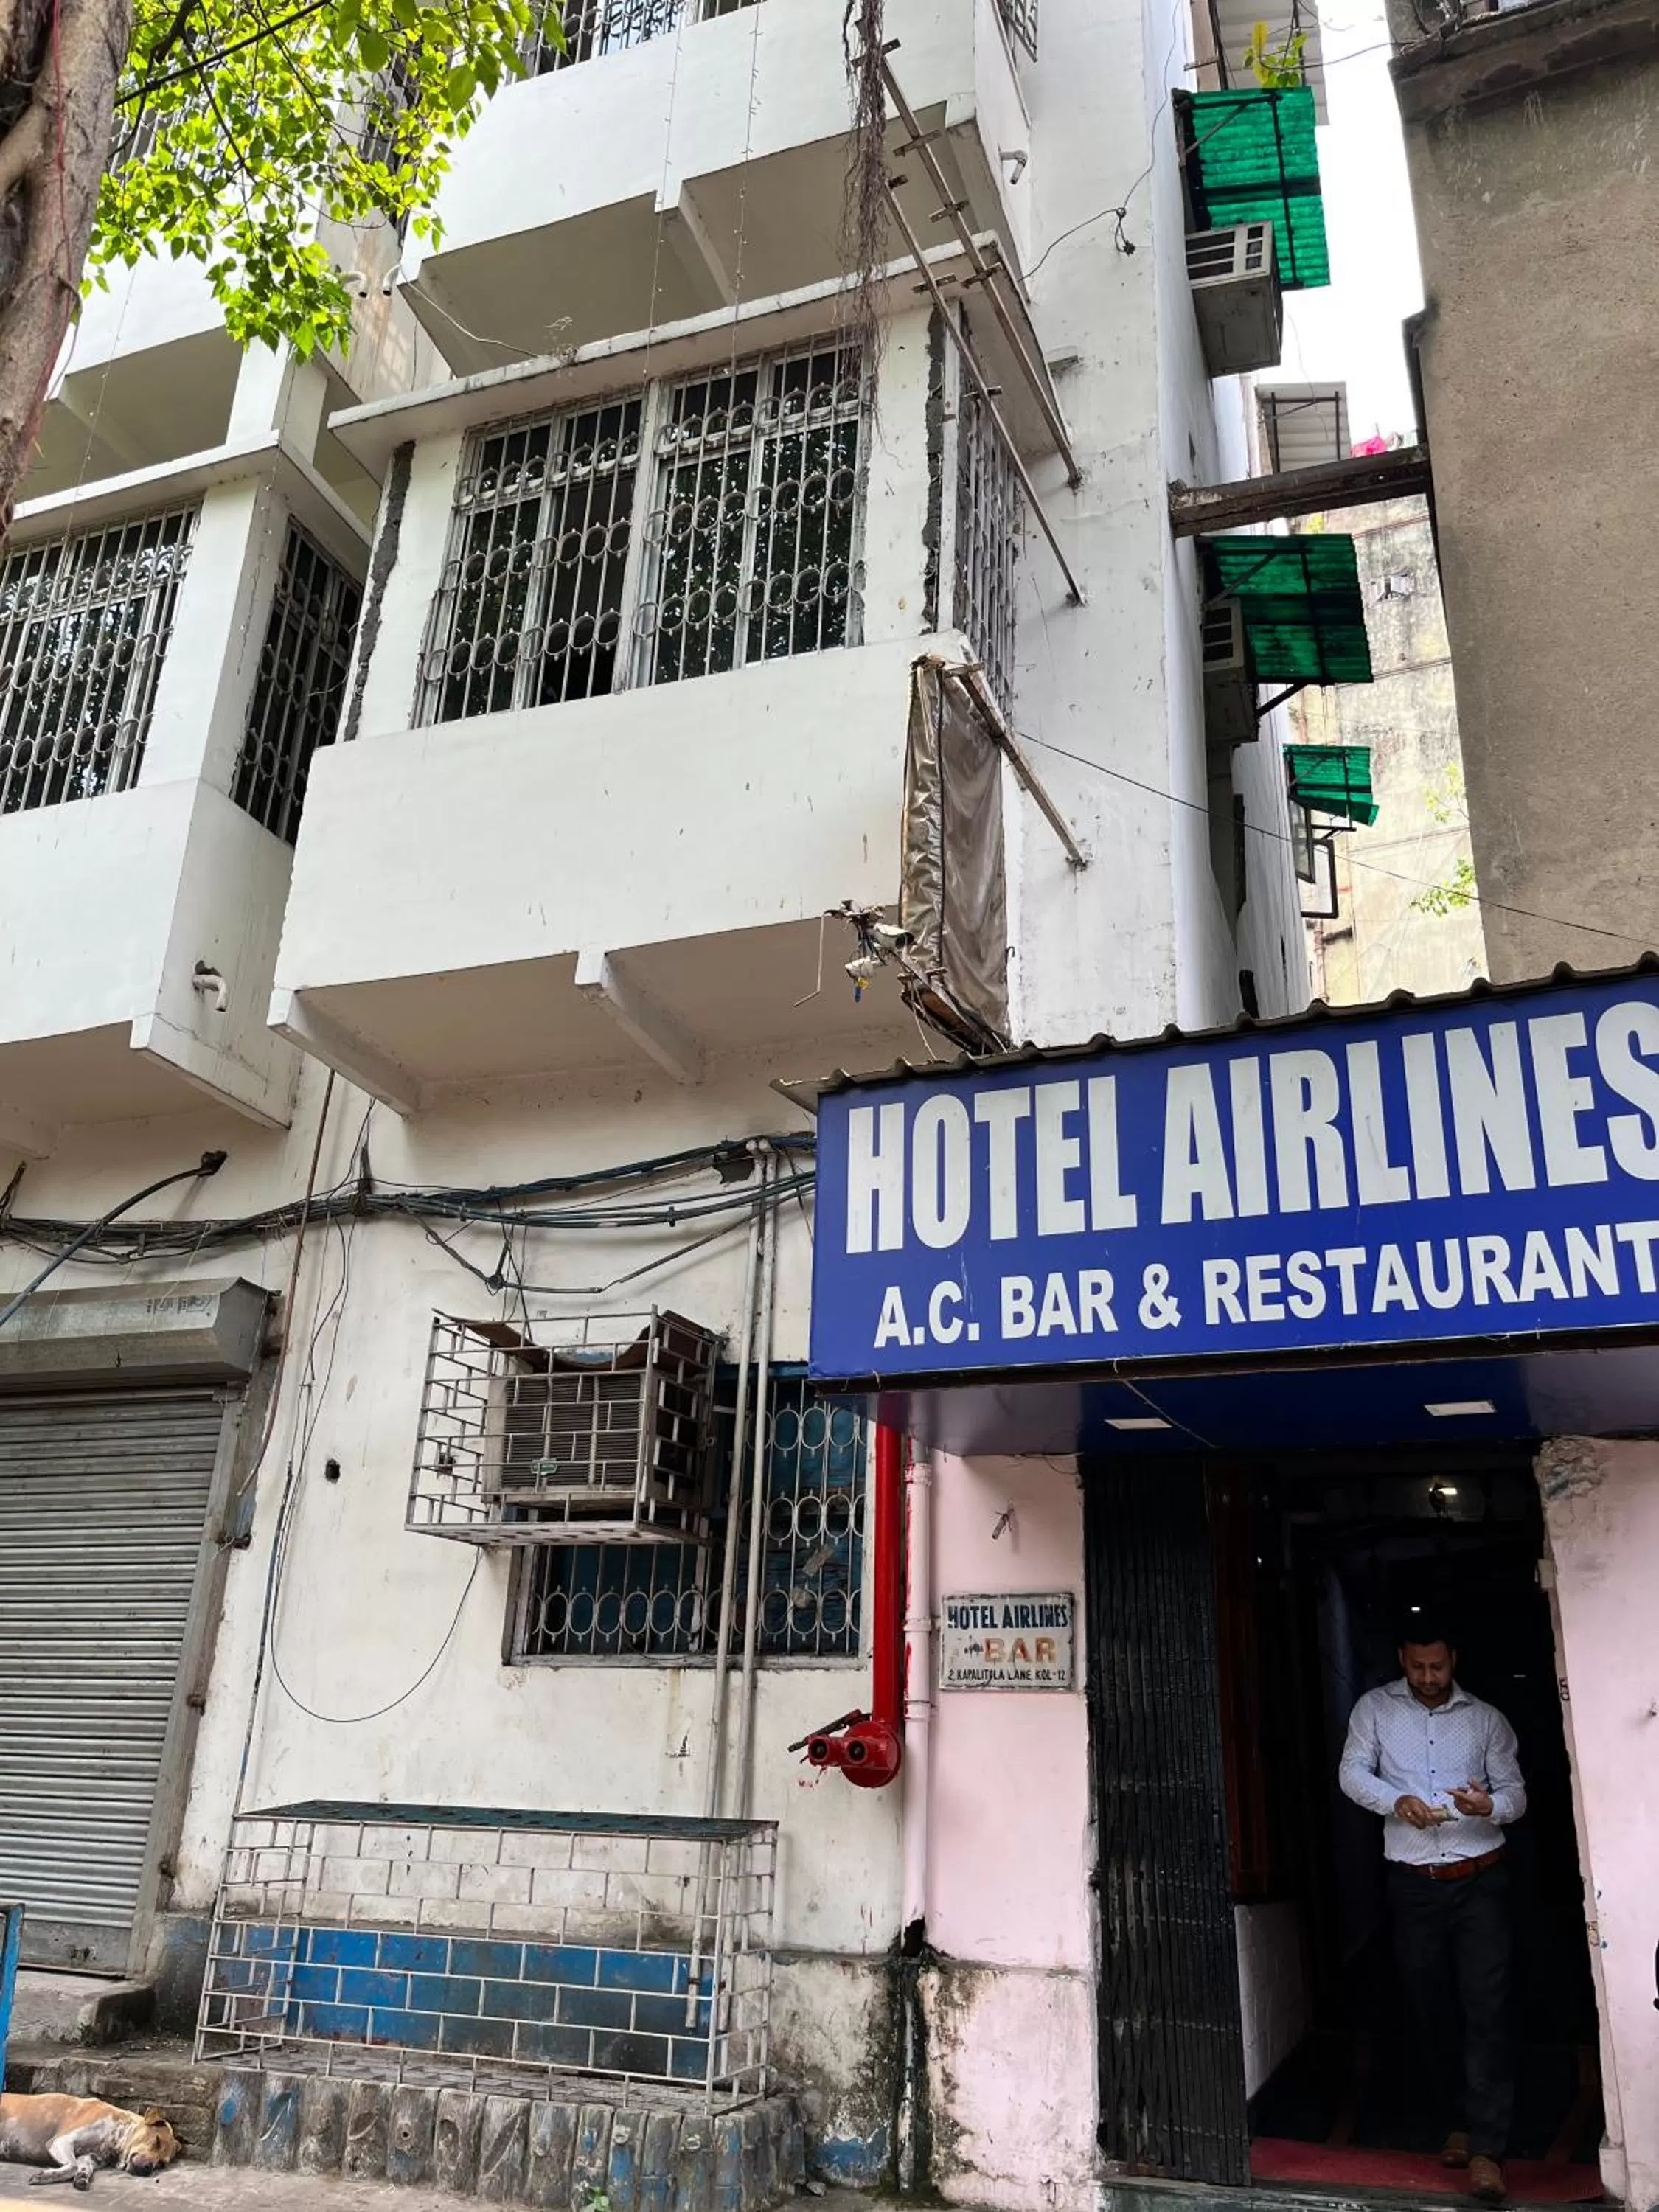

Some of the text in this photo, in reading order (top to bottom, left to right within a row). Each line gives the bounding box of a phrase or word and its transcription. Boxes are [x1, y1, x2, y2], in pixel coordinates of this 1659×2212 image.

[845, 1001, 1659, 1254] HOTEL AIRLINES
[873, 1220, 1659, 1349] A.C. BAR & RESTAURANT
[947, 1604, 1068, 1630] HOTEL AIRLINES
[984, 1636, 1057, 1663] BAR
